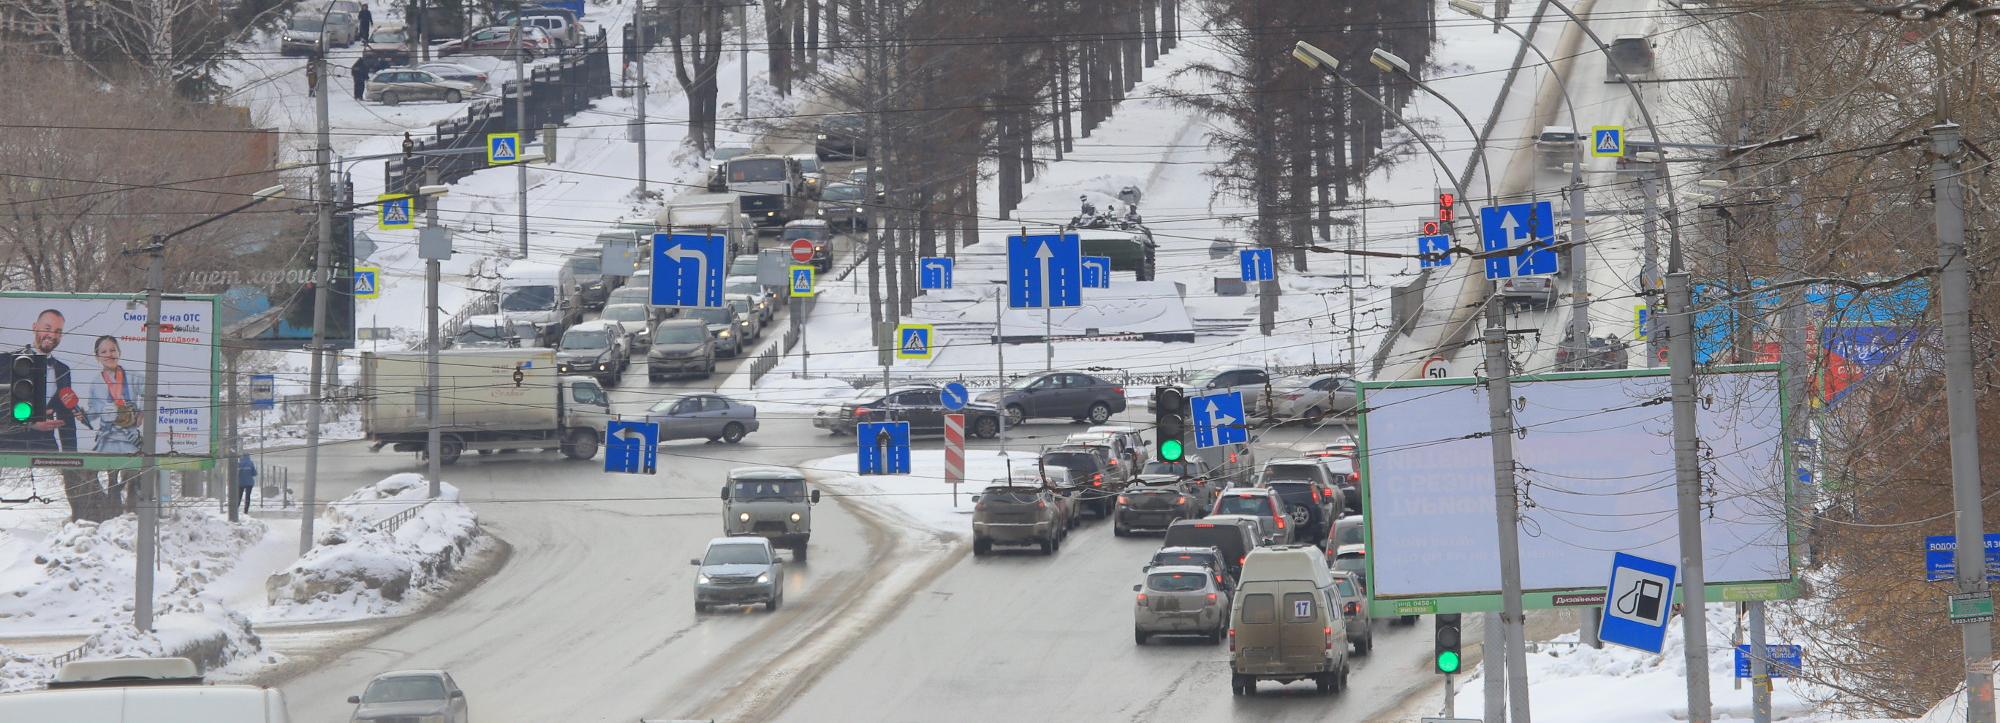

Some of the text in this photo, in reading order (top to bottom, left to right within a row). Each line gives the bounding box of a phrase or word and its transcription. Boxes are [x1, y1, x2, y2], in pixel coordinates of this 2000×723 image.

[169, 313, 181, 322] на
[183, 313, 201, 322] ОТС
[1429, 367, 1447, 379] 50
[1295, 601, 1309, 616] 17
